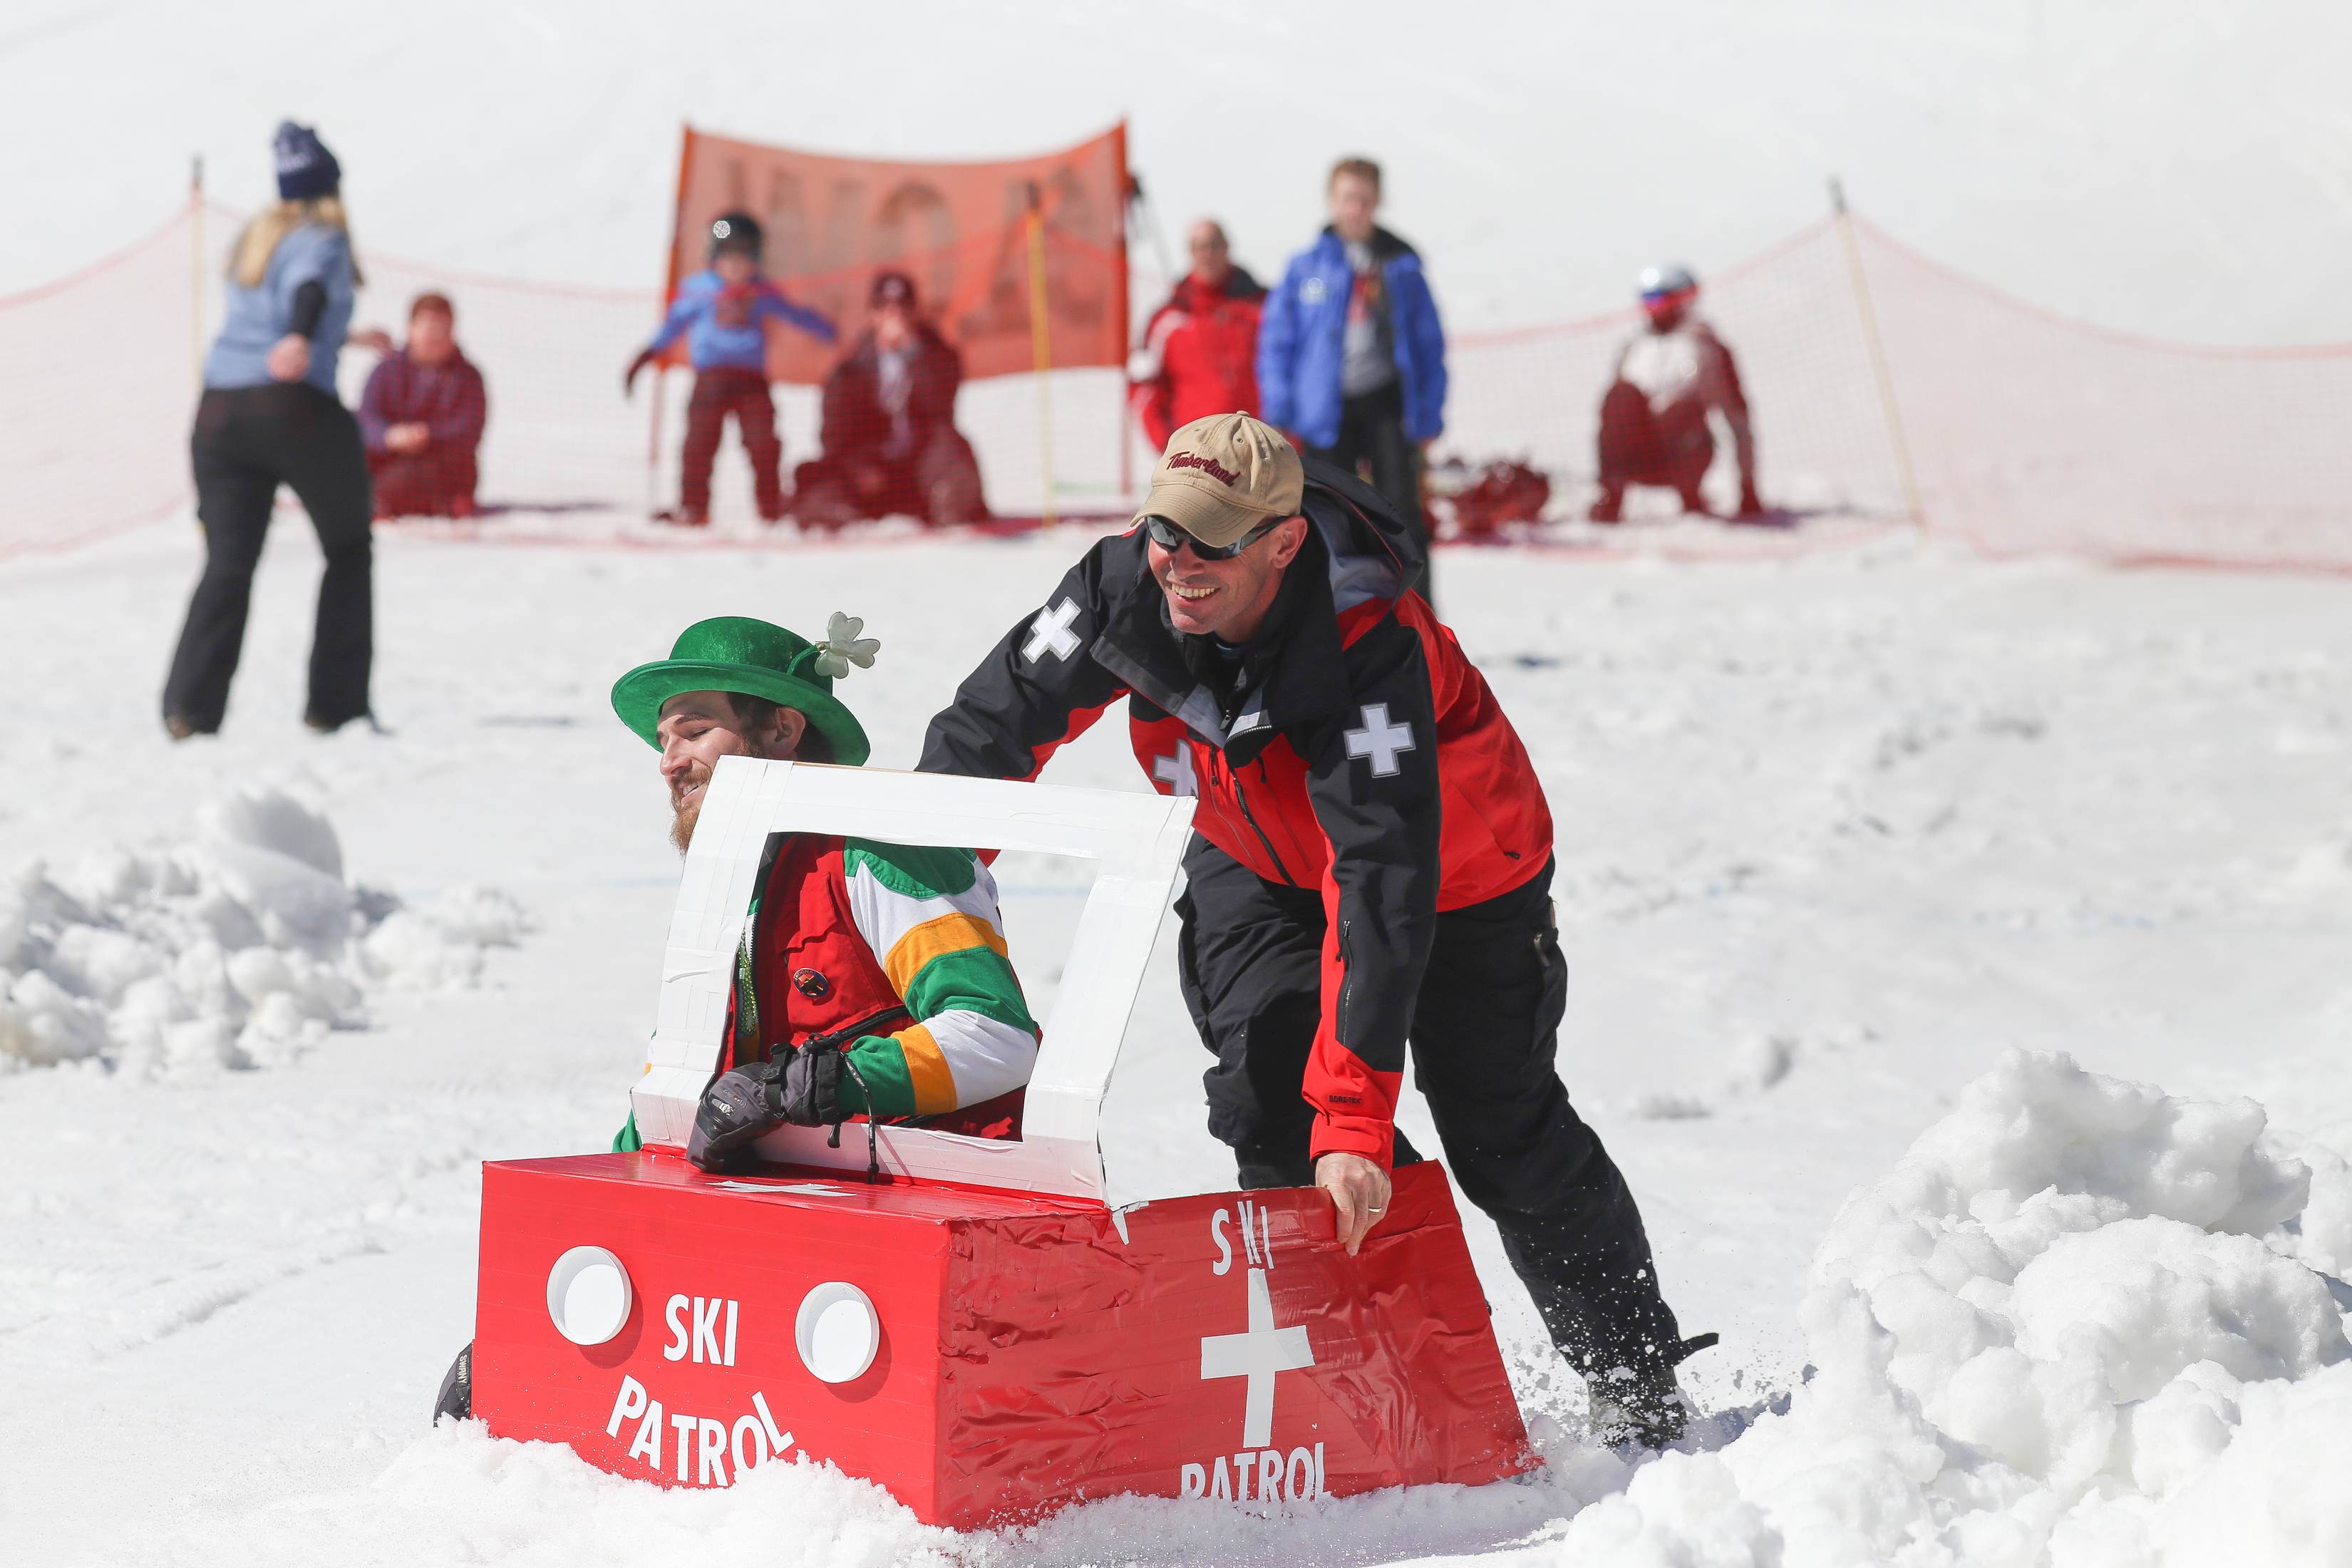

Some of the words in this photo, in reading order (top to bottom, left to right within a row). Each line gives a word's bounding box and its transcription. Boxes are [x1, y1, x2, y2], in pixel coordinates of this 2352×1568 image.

[1166, 450, 1241, 488] Timberland
[1212, 1200, 1274, 1276] SKI
[663, 1293, 739, 1367] SKI
[458, 1354, 468, 1383] SWANY
[606, 1373, 795, 1487] PATROL
[1180, 1442, 1331, 1503] PATROL
